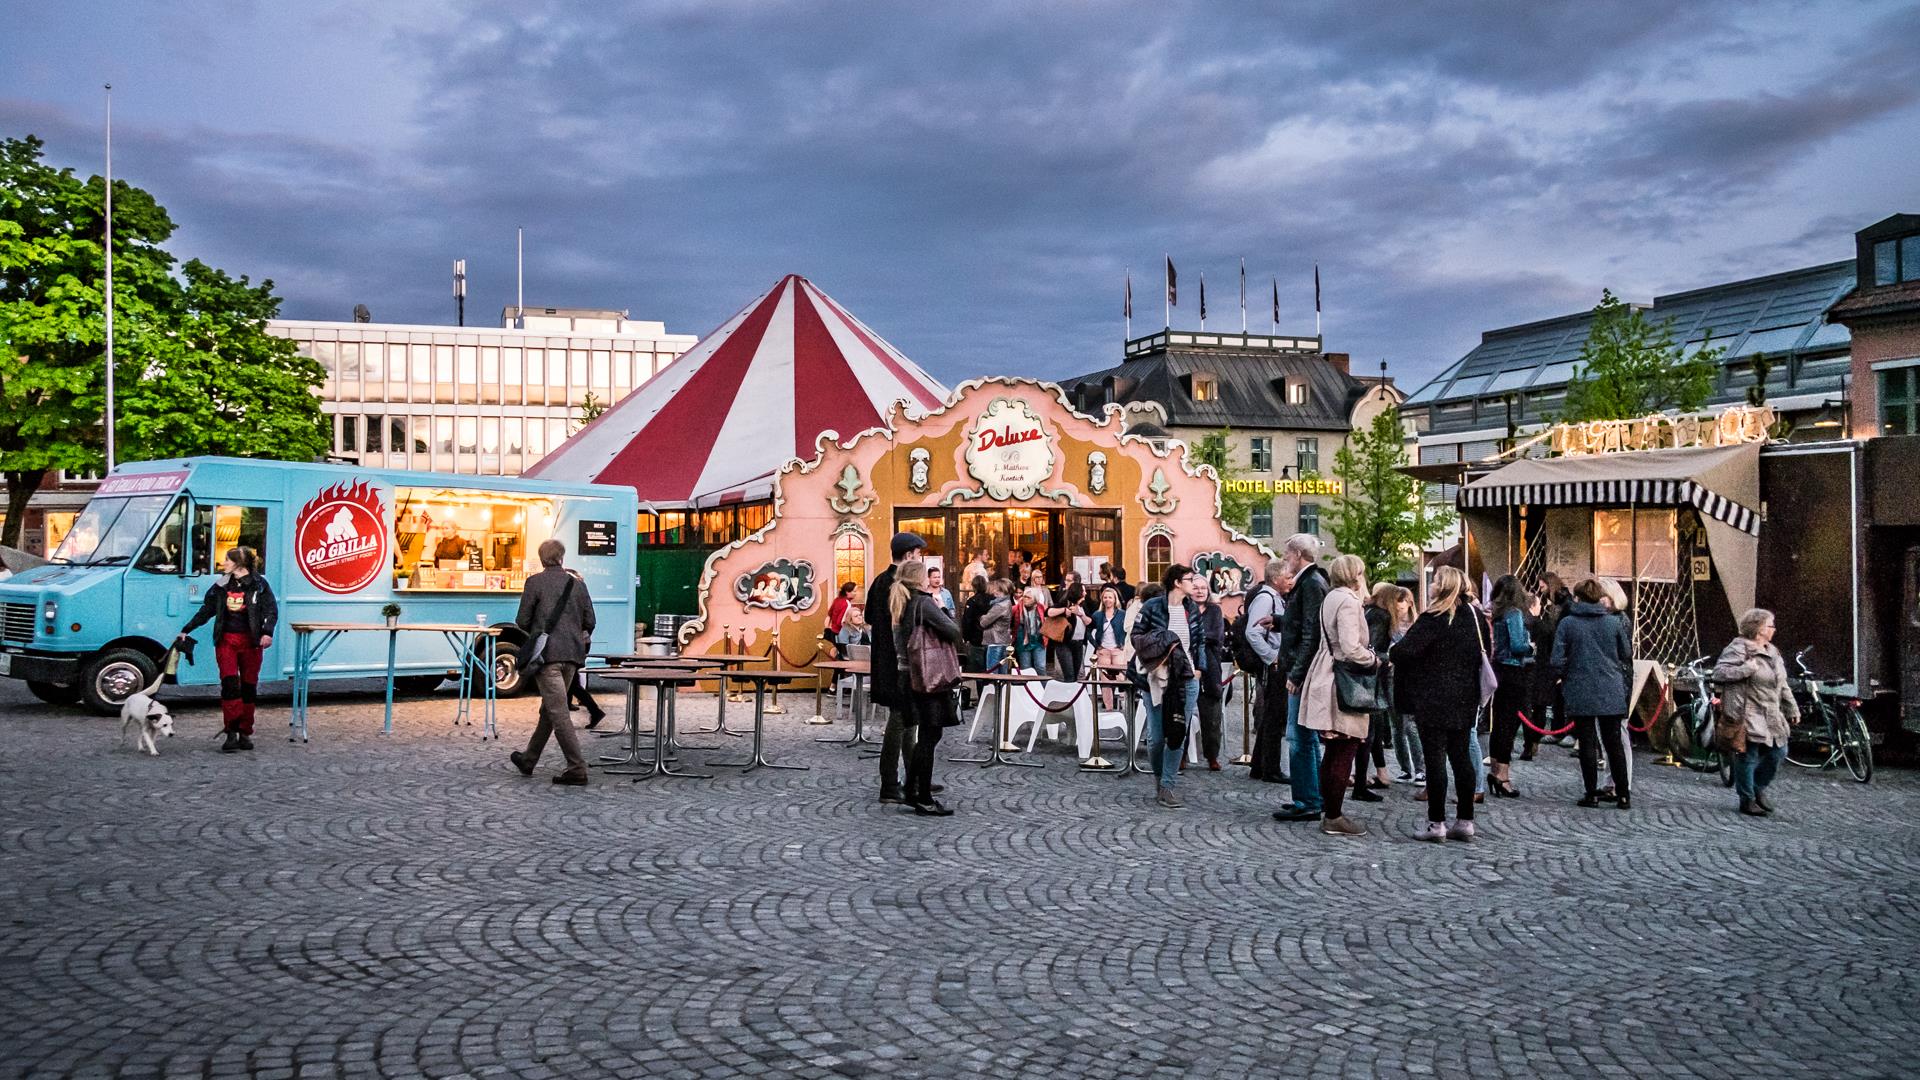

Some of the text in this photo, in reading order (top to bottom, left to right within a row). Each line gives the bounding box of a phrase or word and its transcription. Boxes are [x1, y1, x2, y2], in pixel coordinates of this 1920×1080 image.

[978, 425, 1042, 452] Deluxe
[1226, 479, 1271, 493] HOTEL
[1274, 480, 1343, 494] BREISETH
[328, 534, 378, 558] GRILLA
[341, 556, 358, 564] STREET
